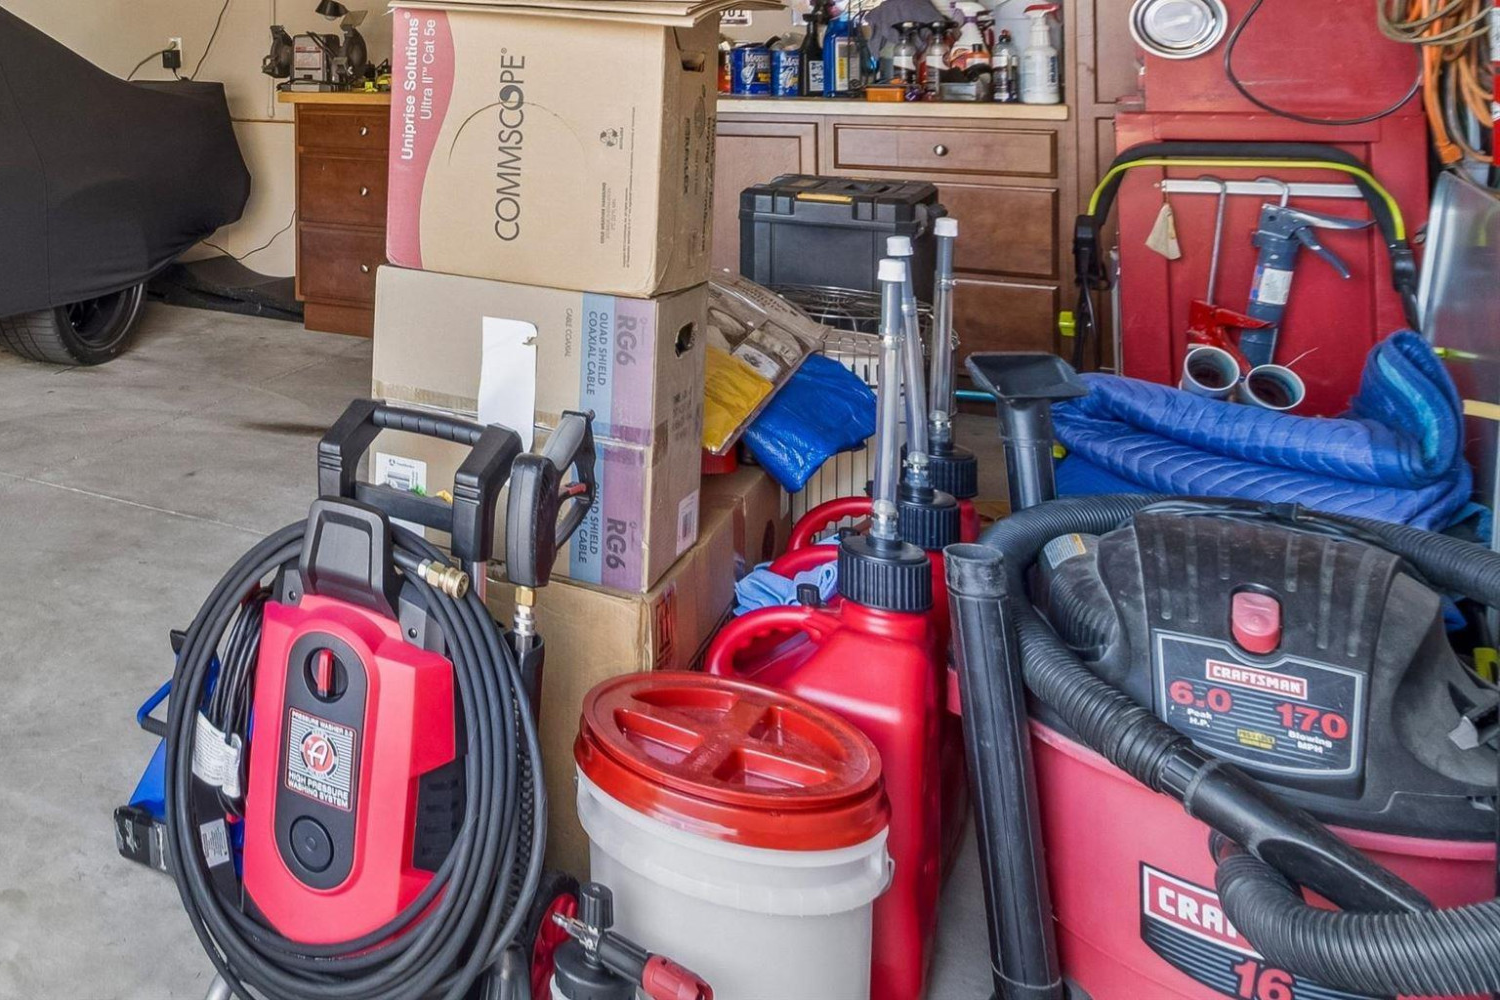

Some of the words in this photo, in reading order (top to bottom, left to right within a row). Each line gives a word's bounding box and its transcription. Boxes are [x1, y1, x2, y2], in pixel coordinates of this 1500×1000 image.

[423, 18, 436, 37] 5e
[422, 39, 435, 65] Cat
[420, 87, 434, 120] Ultra
[401, 95, 418, 160] Uniprise
[587, 310, 598, 361] COAXIAL
[599, 312, 609, 346] QUAD
[616, 314, 638, 366] RG6
[586, 361, 597, 395] CABLE
[597, 348, 608, 386] SHIELD
[578, 529, 588, 563] CABLE
[589, 516, 599, 555] SHIELD
[605, 517, 627, 570] RG6
[1212, 665, 1302, 694] CRAFTSMAN
[1169, 680, 1233, 713] 6.0
[1275, 702, 1349, 739] 170
[1186, 707, 1213, 721] Peak
[1188, 717, 1211, 728] H.P.
[1288, 730, 1333, 749] Blowing
[1297, 741, 1324, 754] MPH
[288, 780, 318, 798] WASHING
[319, 790, 349, 809] SYSTEM
[289, 771, 307, 783] HIGH
[307, 777, 349, 799] PRESSURE
[1233, 960, 1294, 1000] 16
